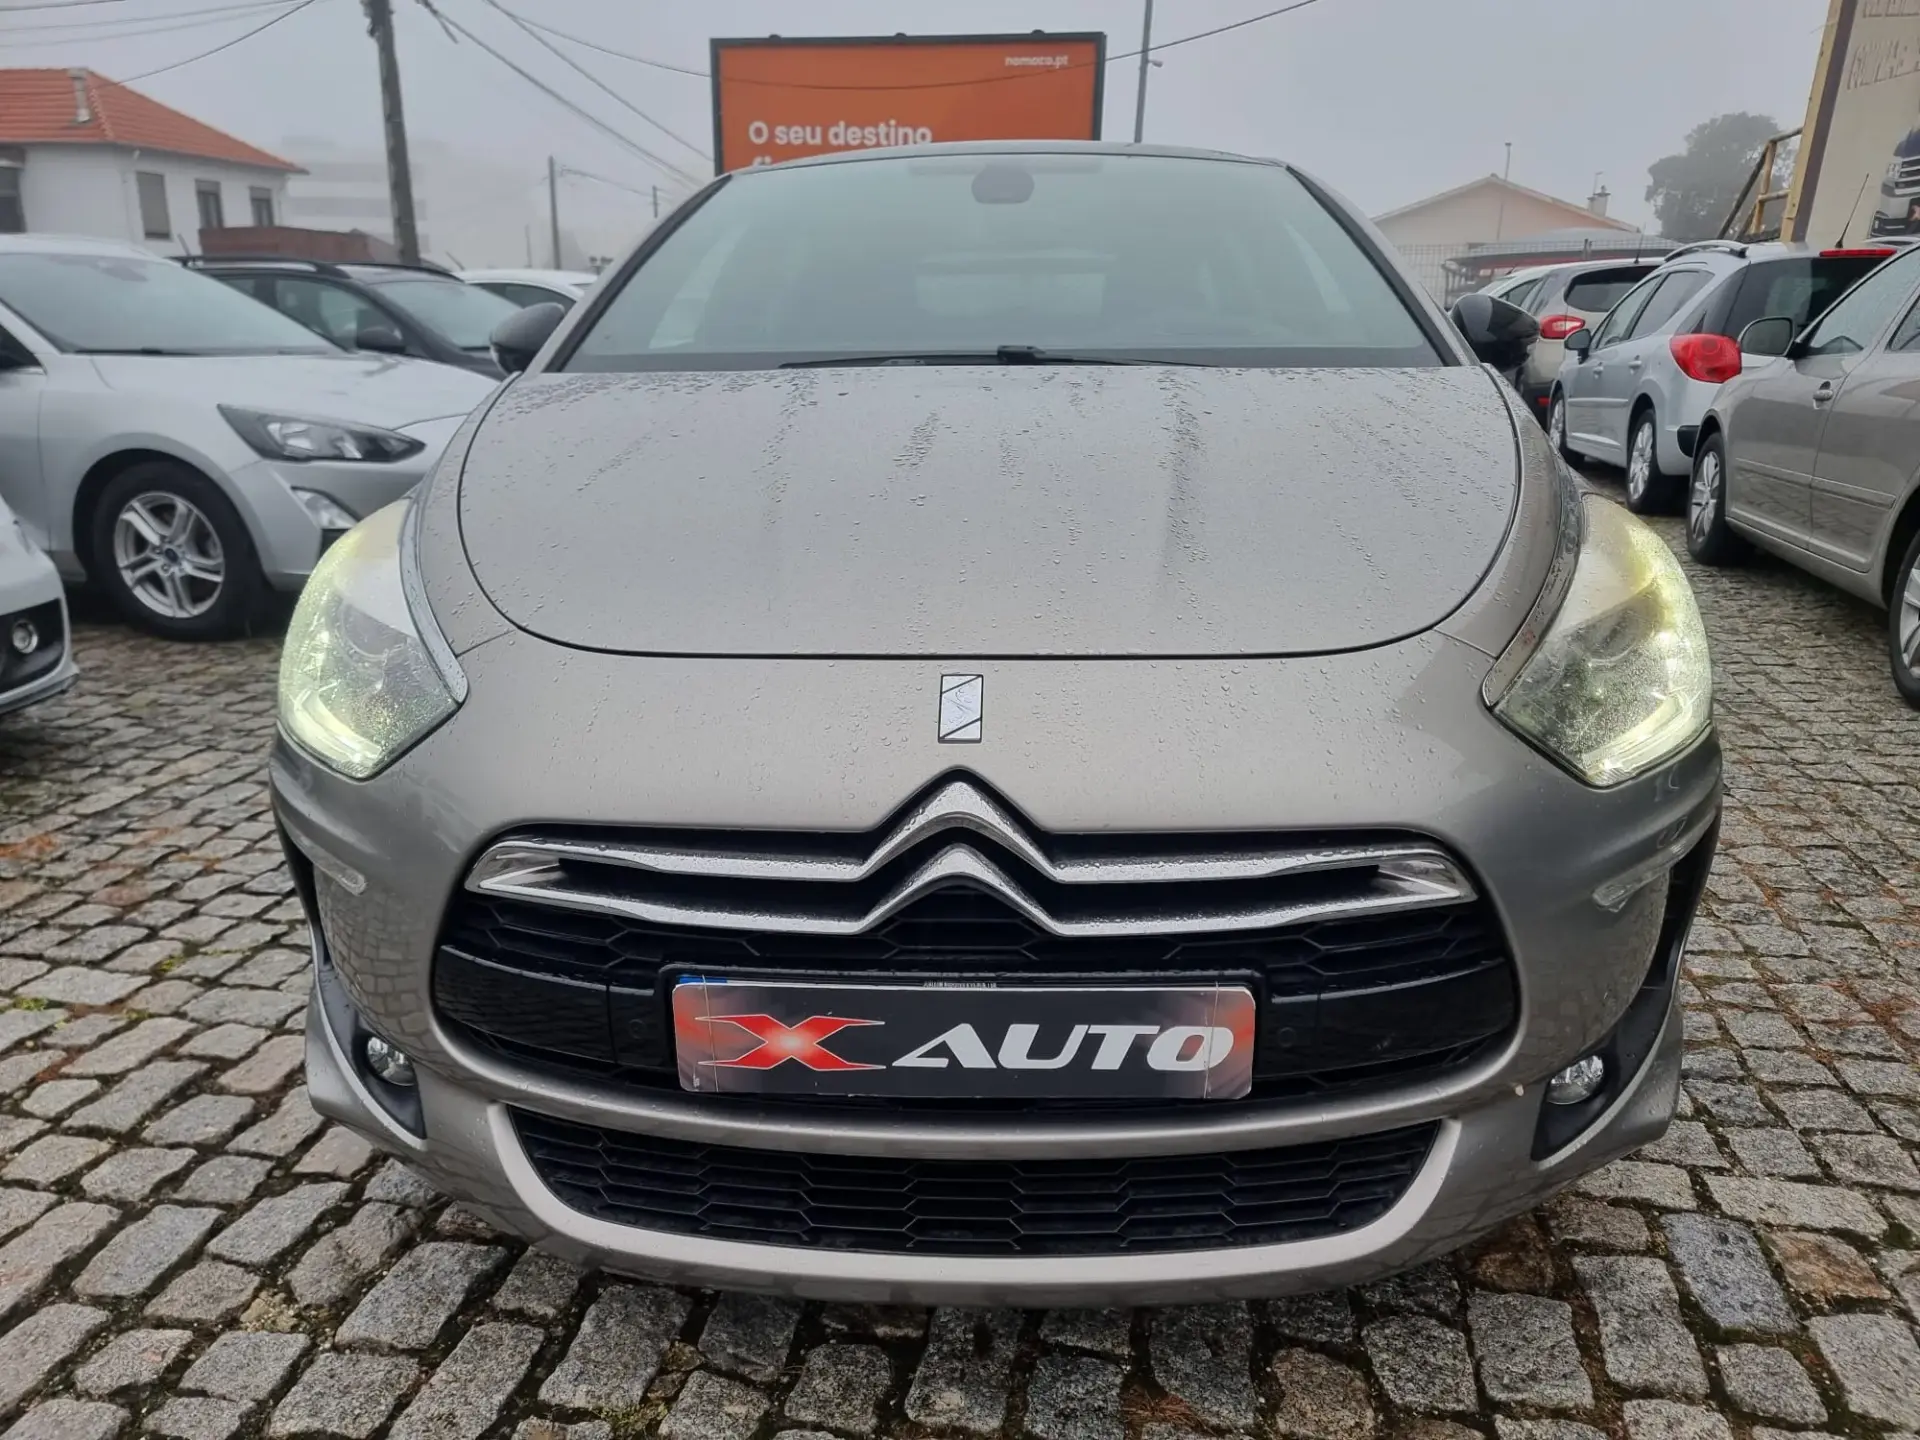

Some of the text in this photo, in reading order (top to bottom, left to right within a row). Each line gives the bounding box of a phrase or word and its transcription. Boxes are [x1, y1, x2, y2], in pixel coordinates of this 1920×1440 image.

[748, 119, 932, 146] O seu destino
[891, 1022, 1235, 1071] AUTO
